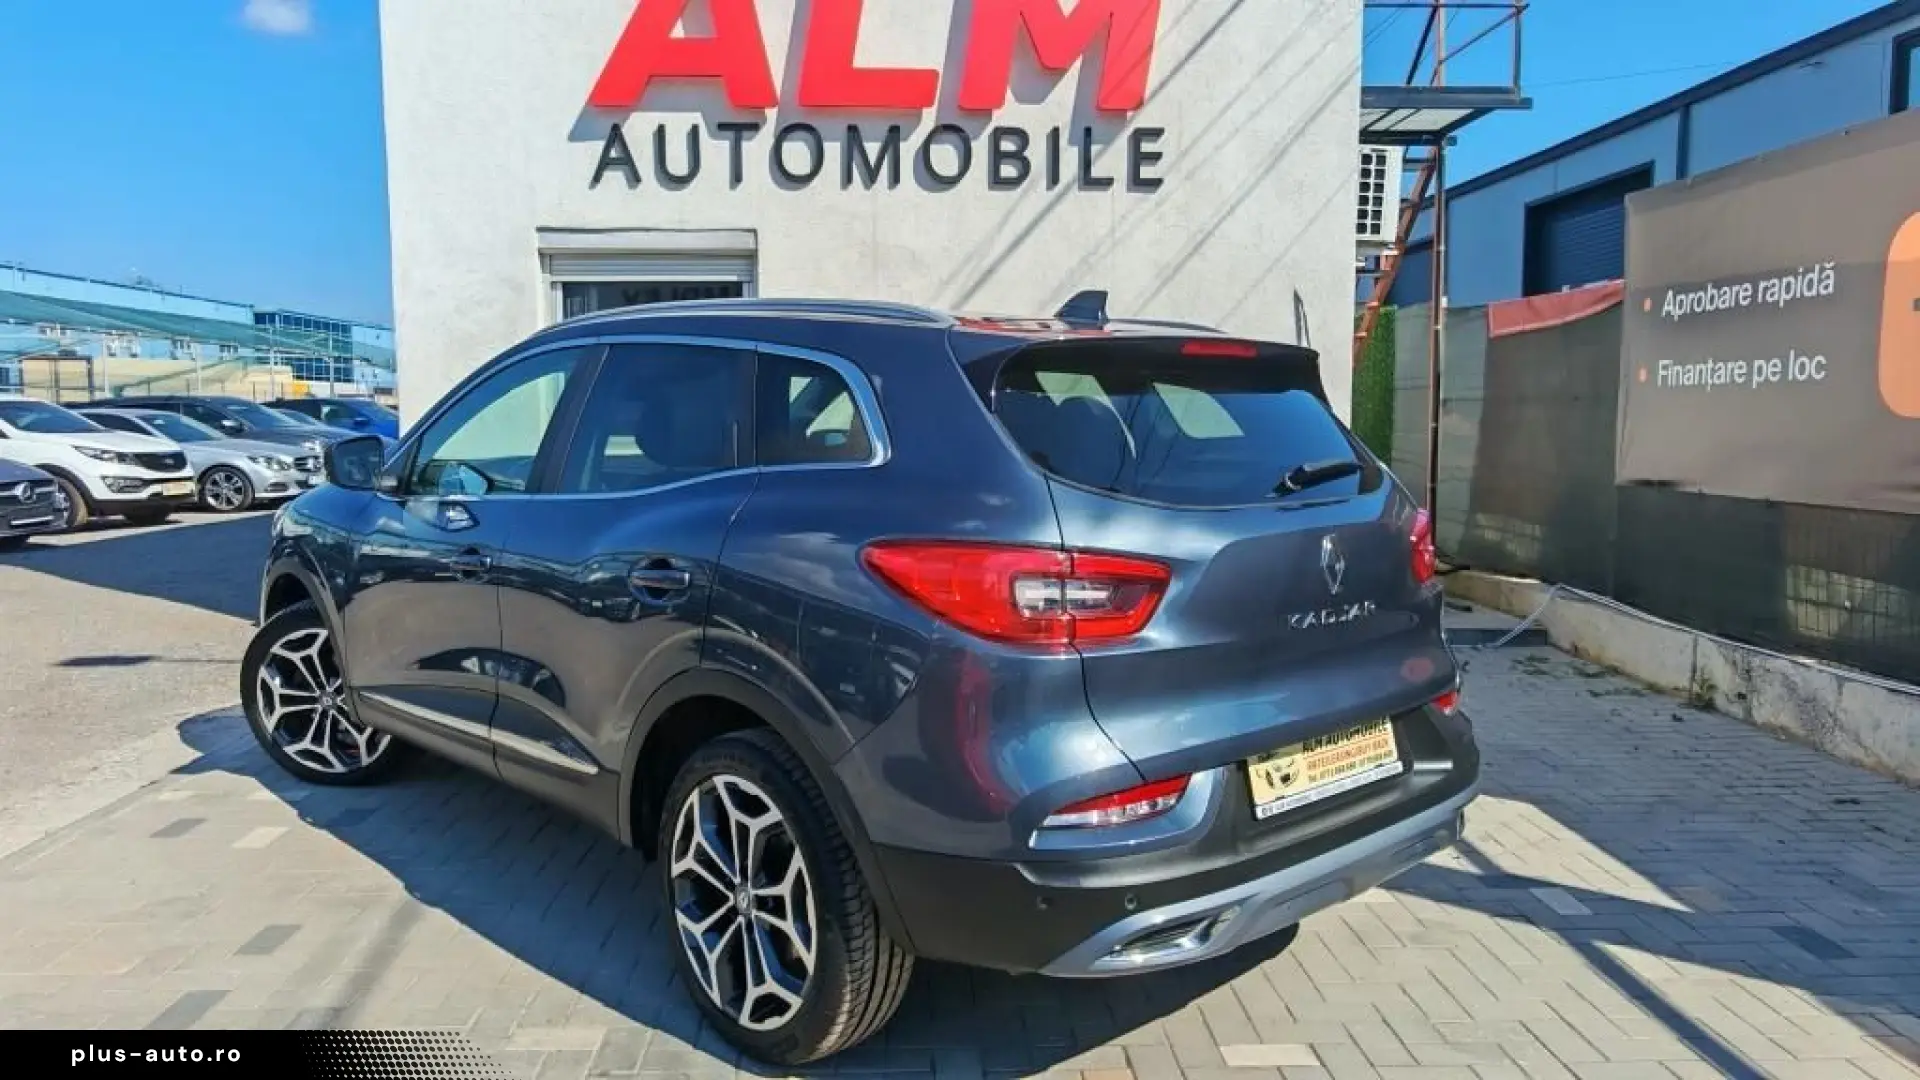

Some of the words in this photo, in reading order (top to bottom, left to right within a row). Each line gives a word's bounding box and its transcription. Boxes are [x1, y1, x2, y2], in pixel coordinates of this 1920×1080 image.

[586, 0, 1161, 111] ALM
[591, 122, 1165, 188] AUTOMOBILE
[1661, 282, 1752, 321] Aprobare
[1757, 261, 1836, 308] rapidă
[1657, 357, 1747, 391] Finanțare
[1752, 356, 1782, 389] pe
[1787, 349, 1828, 382] loc
